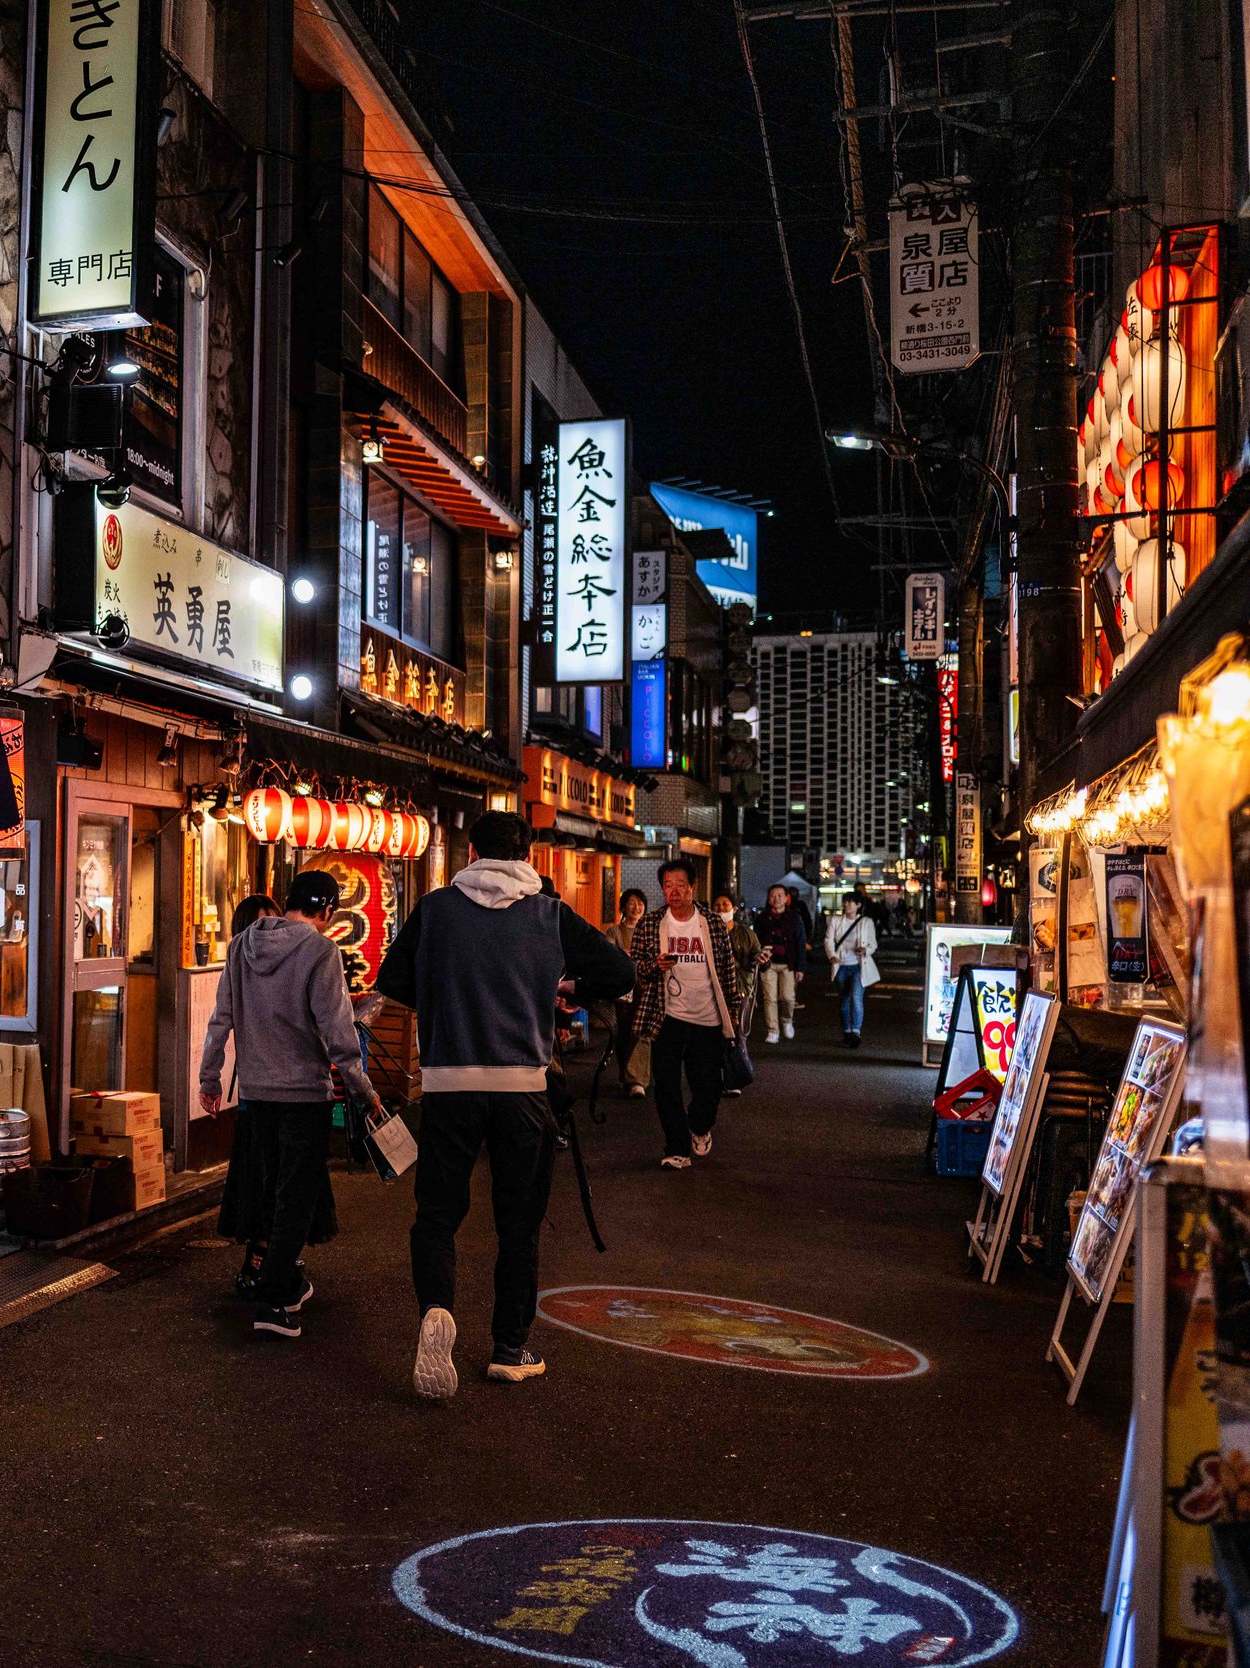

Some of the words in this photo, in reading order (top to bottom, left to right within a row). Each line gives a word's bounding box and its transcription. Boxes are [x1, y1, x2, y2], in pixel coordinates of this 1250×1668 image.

[47, 249, 133, 287] 専門店
[901, 260, 969, 295] 質店
[899, 345, 971, 362] 03-3431-3049
[565, 437, 617, 658] 魚金総本店
[104, 578, 121, 604] 炭火
[637, 555, 651, 598] あすか
[152, 571, 235, 660] 英勇屋
[643, 685, 653, 762] PICCOLO
[252, 795, 263, 833] キリンビール
